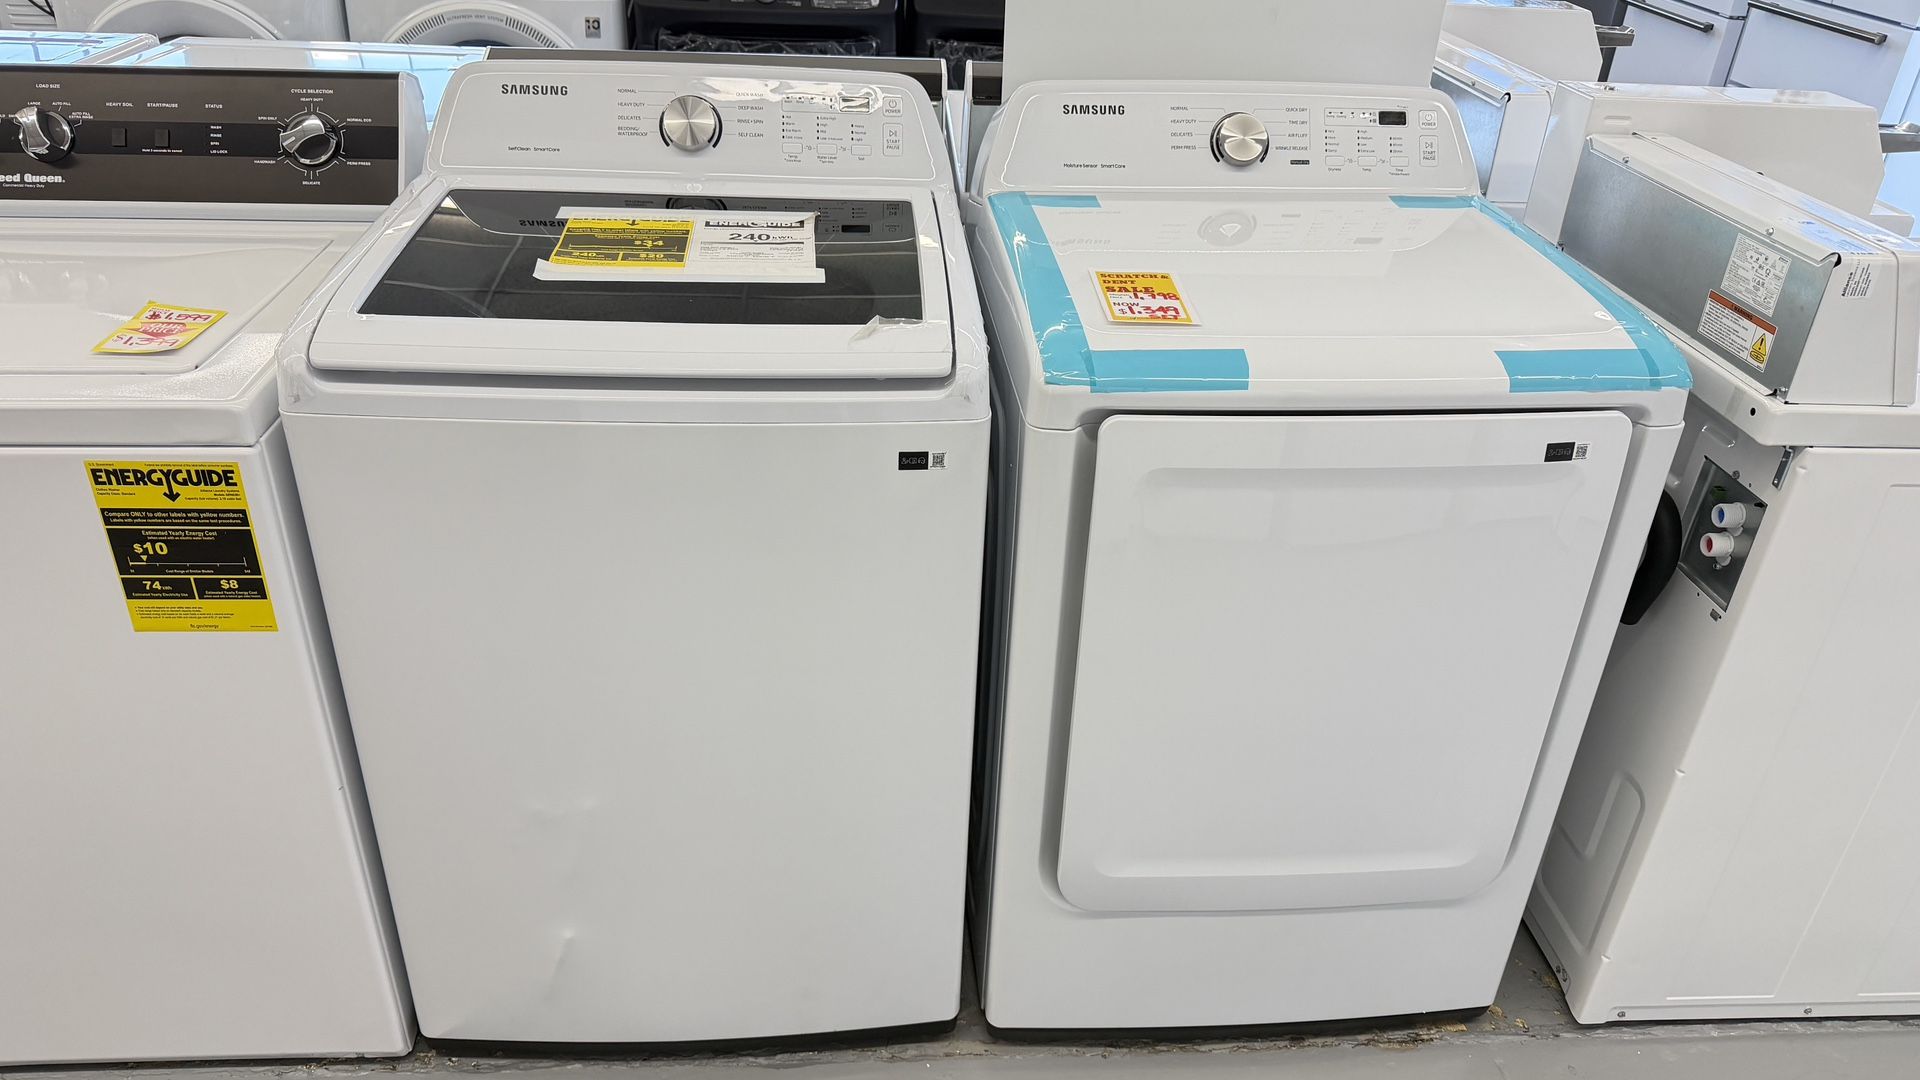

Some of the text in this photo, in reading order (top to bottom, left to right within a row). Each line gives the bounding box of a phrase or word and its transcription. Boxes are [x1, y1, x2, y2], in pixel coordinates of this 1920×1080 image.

[501, 84, 568, 96] SAMSUNG
[1062, 104, 1125, 115] SAMSUNG
[728, 232, 771, 241] 240
[90, 468, 238, 495] ENERGYGUIDE
[132, 542, 168, 555] $10
[142, 580, 162, 590] 74
[220, 579, 238, 589] $8
